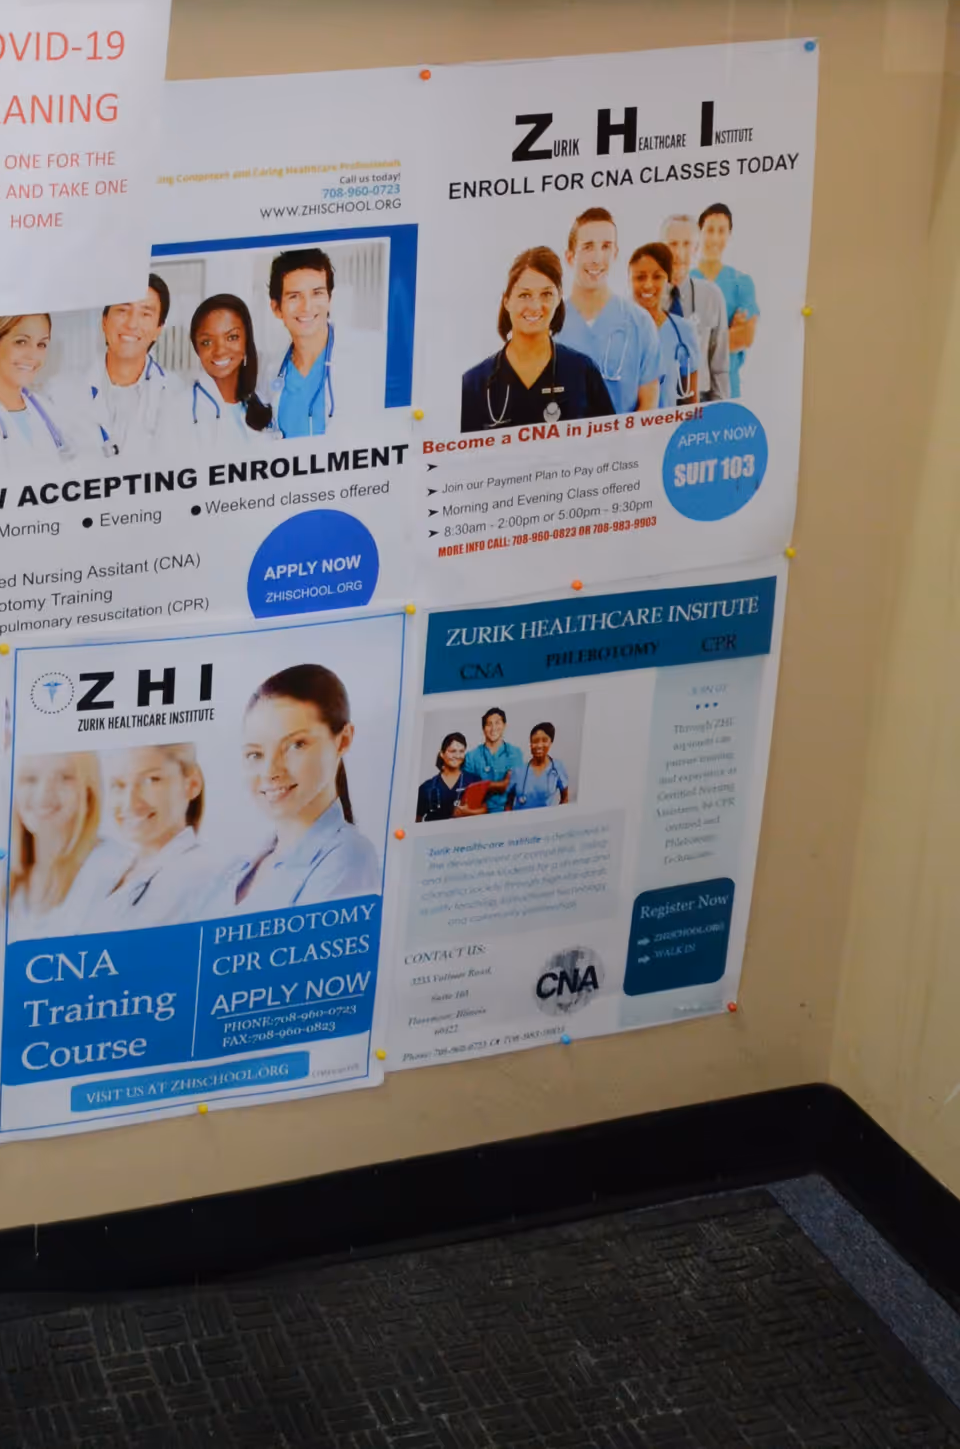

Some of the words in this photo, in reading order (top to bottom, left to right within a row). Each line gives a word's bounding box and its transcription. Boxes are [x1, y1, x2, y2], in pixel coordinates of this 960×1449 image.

[512, 112, 580, 163] ZURIK
[596, 106, 687, 156] HEALTHCARE
[700, 101, 753, 147] INSTITUTE
[4, 154, 40, 170] ONE
[47, 152, 80, 169] FOR
[86, 151, 116, 167] THE
[449, 177, 535, 200] ENROLL
[541, 172, 584, 193] FOR
[591, 168, 634, 188] CNA
[640, 160, 731, 184] CLASSES
[736, 152, 800, 175] TODAY
[6, 183, 44, 199] AND
[49, 181, 90, 198] TAKE
[95, 179, 128, 195] ONE
[322, 184, 401, 199] 708-960-0723
[340, 175, 357, 185] Call
[359, 175, 370, 183] us
[370, 172, 401, 184] today!
[10, 212, 63, 229] HOME
[260, 199, 402, 219] WWW.ZHISCHOOL.ORG
[422, 434, 496, 454] Become
[501, 433, 512, 445] a
[518, 423, 560, 443] CNA
[566, 422, 582, 437] in
[586, 420, 620, 439] just
[625, 416, 636, 430] 8
[640, 406, 704, 427] weeks!!
[678, 430, 721, 448] APPLY
[723, 424, 758, 441] NOW
[17, 466, 198, 508] ACCEPTING
[208, 444, 409, 487] ENROLLMENT
[442, 480, 464, 494] Join
[467, 480, 484, 490] our
[486, 472, 533, 490] Payment
[535, 468, 558, 482] Plan
[560, 468, 571, 478] to
[574, 466, 593, 480] Pay
[596, 462, 610, 475] off
[612, 459, 640, 472] Class
[674, 458, 718, 487] SUIT
[721, 454, 755, 480] 103
[100, 508, 162, 528] Evening
[205, 494, 276, 515] Weekend
[280, 486, 336, 507] classes
[339, 481, 390, 500] offered
[443, 501, 489, 519] Morning
[492, 498, 514, 510] and
[518, 490, 564, 509] Evening
[567, 486, 599, 500] Class
[602, 480, 641, 496] offered
[444, 522, 487, 538] 8:30am
[498, 513, 540, 530] 2:00pm
[543, 511, 555, 522] or
[558, 506, 601, 524] 5:00pm
[612, 499, 653, 517] 9:30pm
[438, 543, 464, 558] MORE
[466, 540, 486, 554] INFO
[487, 536, 511, 550] CALL:
[578, 524, 591, 536] OR
[22, 565, 84, 588] Nursing
[86, 559, 149, 580] Assitant
[152, 552, 202, 574] (CNA)
[264, 560, 318, 581] APPLY
[322, 554, 362, 574] NOW
[50, 586, 113, 610] Training
[265, 580, 363, 603] ZHISCHOOL.ORG
[75, 604, 164, 627] resuscitation
[167, 597, 209, 618] (CPR)
[446, 624, 515, 647] ZURIK
[520, 606, 663, 640] HEALTHCARE
[668, 596, 759, 623] INSITUTE
[460, 662, 504, 681] CNA
[546, 641, 660, 668] PHLEBOTOMY
[701, 634, 737, 652] CPR
[76, 671, 114, 711] Z
[137, 667, 176, 707] H
[200, 663, 213, 701] I
[78, 717, 105, 732] ZURIK
[108, 713, 166, 730] HEALTHCARE
[170, 708, 214, 724] INSTITUTE
[215, 903, 376, 944] PHLEBOTOMY
[640, 900, 695, 919] Register
[698, 894, 730, 909] Now
[25, 949, 119, 985] CNA
[212, 952, 261, 976] CPR
[270, 934, 370, 967] CLASSES
[404, 947, 464, 965] CONTACT
[211, 983, 298, 1015] APPLY
[306, 971, 371, 1001] NOW
[536, 965, 599, 1000] CNA
[24, 990, 177, 1028] Training
[21, 1036, 147, 1071] Course
[86, 1087, 122, 1104] VISIT
[127, 1084, 145, 1098] US
[148, 1081, 168, 1095] AT
[170, 1063, 289, 1093] ZHISCHOOL.ORG
